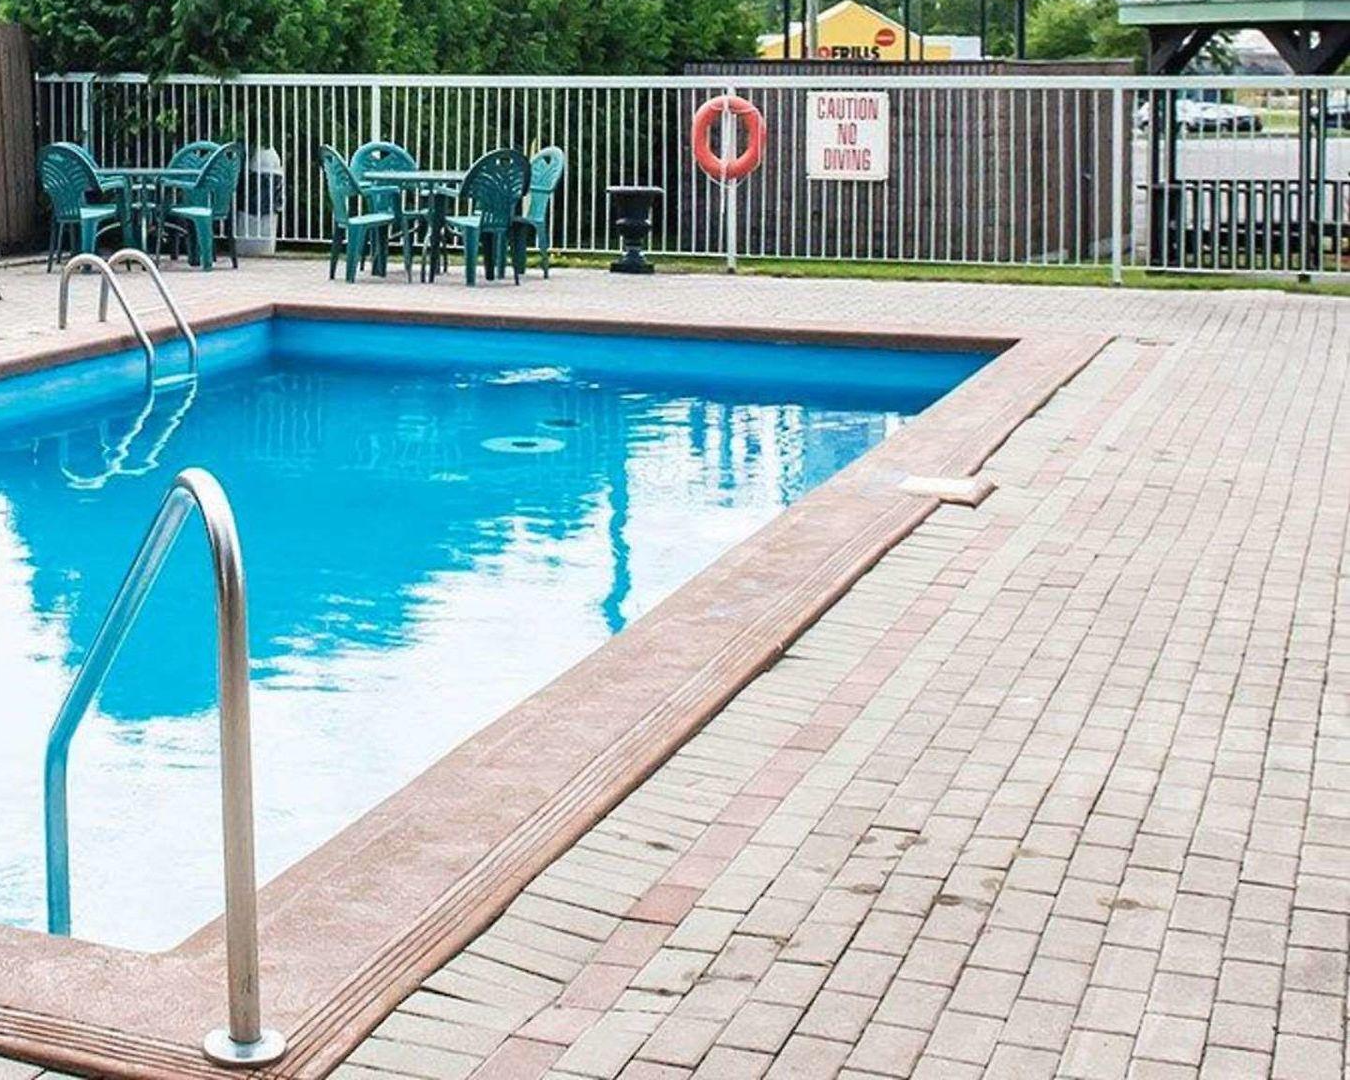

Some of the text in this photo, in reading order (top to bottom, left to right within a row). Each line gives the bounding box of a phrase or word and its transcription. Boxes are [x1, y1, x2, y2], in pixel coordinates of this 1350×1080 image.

[817, 97, 879, 120] CAUTION
[837, 123, 857, 145] NO
[824, 148, 871, 171] DIVING
